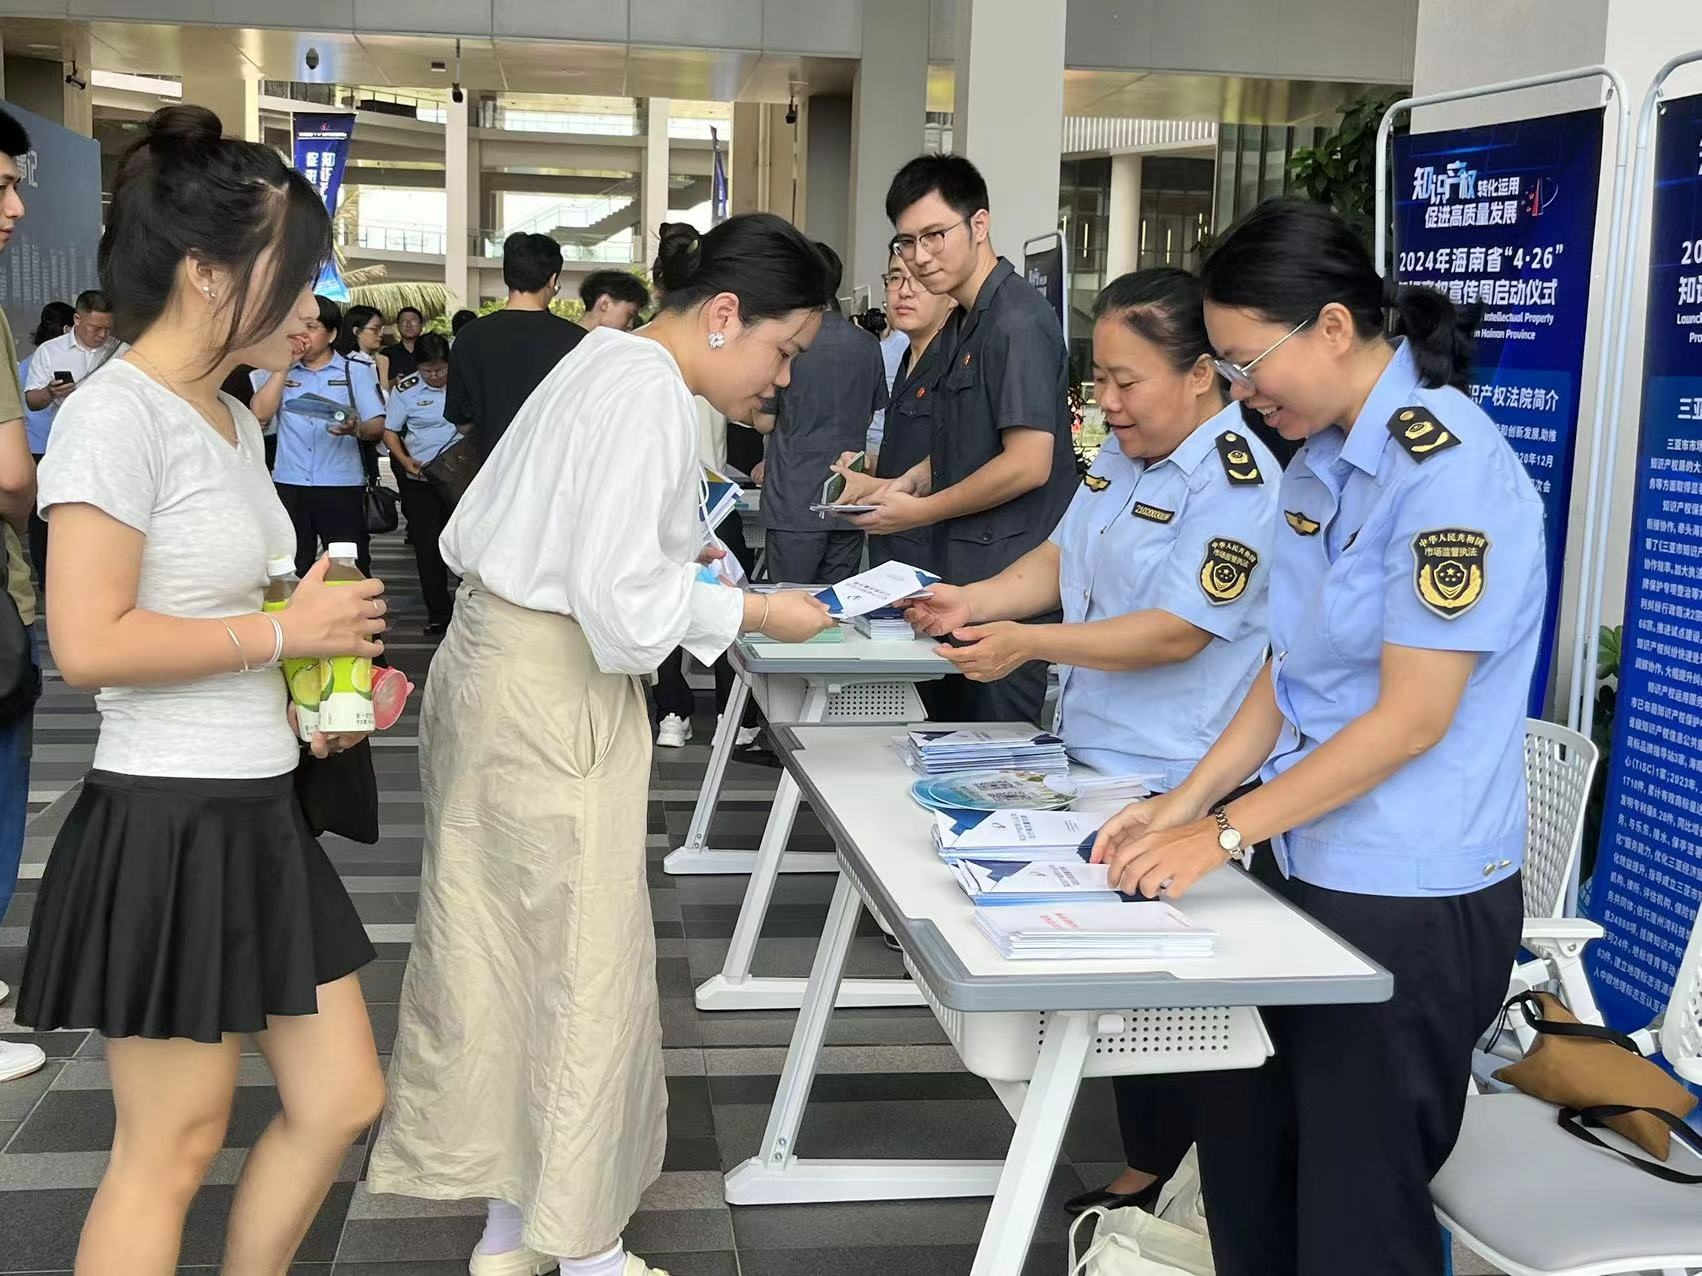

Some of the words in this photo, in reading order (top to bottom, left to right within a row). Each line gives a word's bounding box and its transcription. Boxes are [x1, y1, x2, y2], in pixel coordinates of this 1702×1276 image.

[1412, 160, 1477, 204] 知识产权
[1477, 177, 1520, 198] 转化运用
[1425, 200, 1518, 228] 促进高质量发展
[1524, 313, 1554, 326] Property
[1481, 328, 1505, 338] Hainan
[1506, 329, 1536, 340] Province
[1419, 533, 1485, 547] 中华人民共和国
